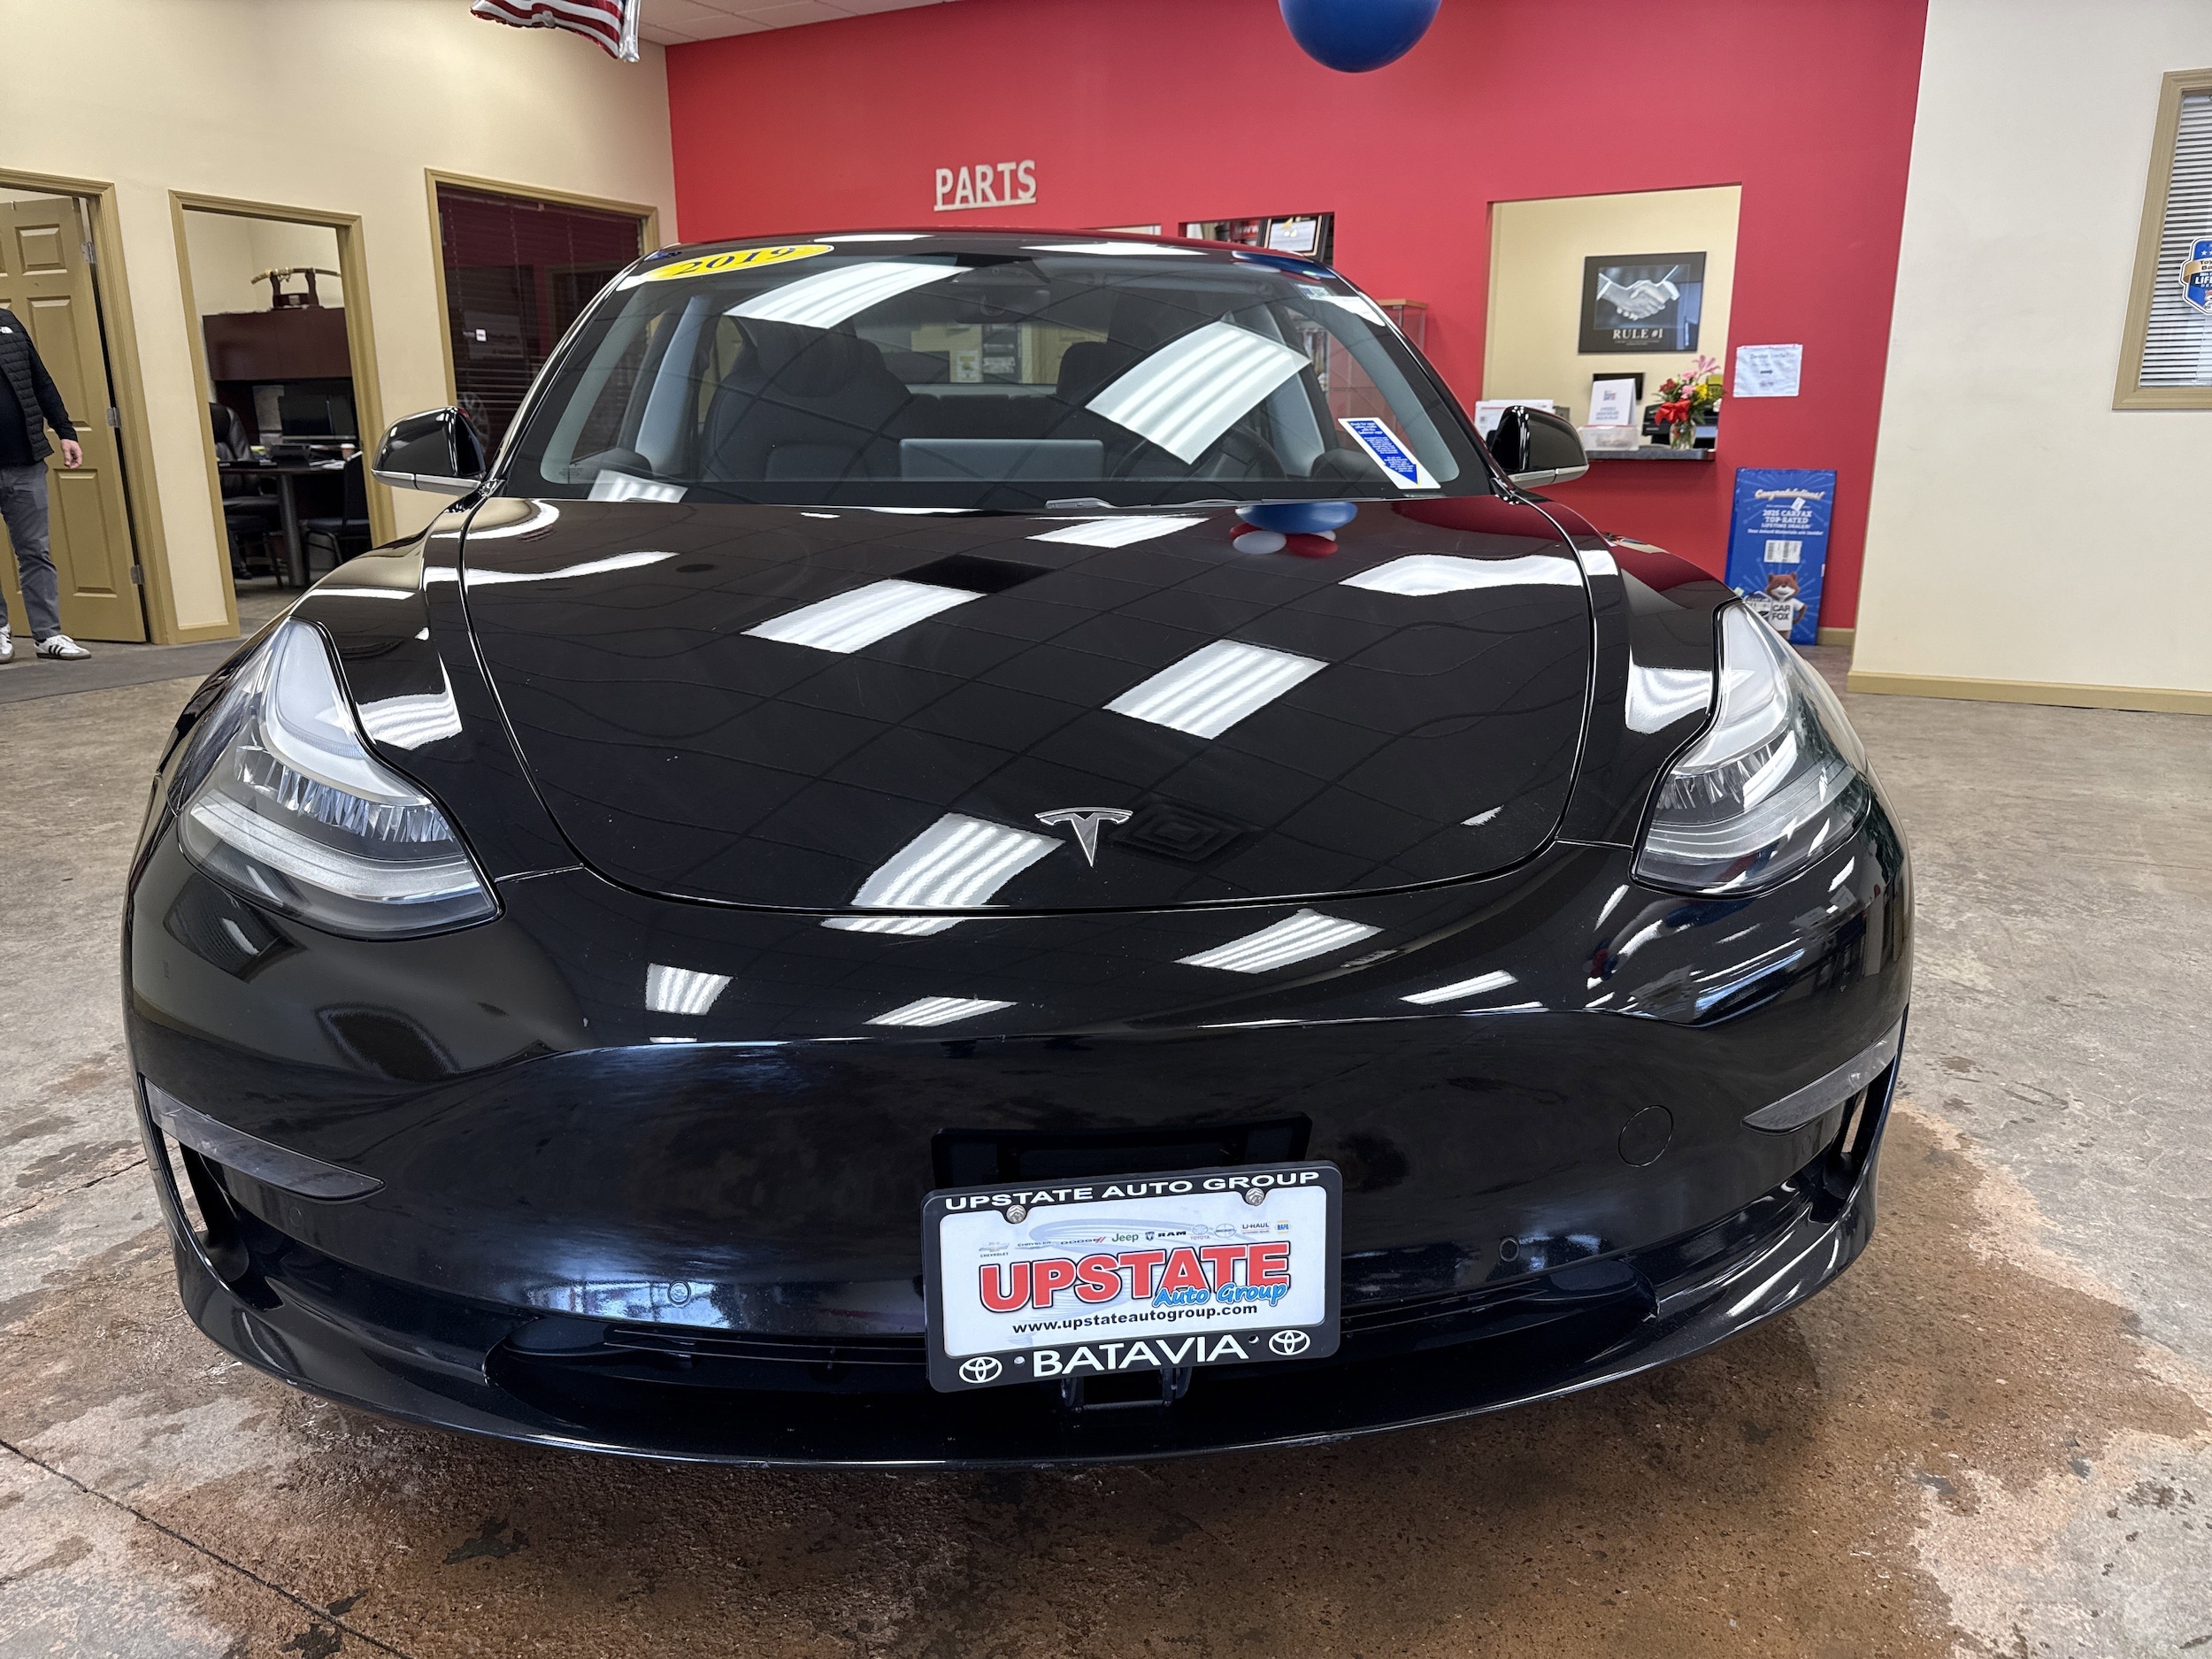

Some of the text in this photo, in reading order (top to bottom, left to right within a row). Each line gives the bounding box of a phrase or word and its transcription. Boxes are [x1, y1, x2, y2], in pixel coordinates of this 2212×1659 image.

[934, 159, 1036, 211] PARTS
[673, 247, 796, 276] 2019
[1612, 328, 1663, 340] RULE #1
[945, 1171, 1319, 1210] UPSTATE AUTO GROUP
[1111, 1233, 1139, 1243] Jeep
[979, 1240, 1291, 1313] UPSTATE
[1152, 1282, 1288, 1308] Auto Group
[1013, 1305, 1257, 1333] www.upstateautogroup.com
[1033, 1334, 1248, 1378] BATAVIA
